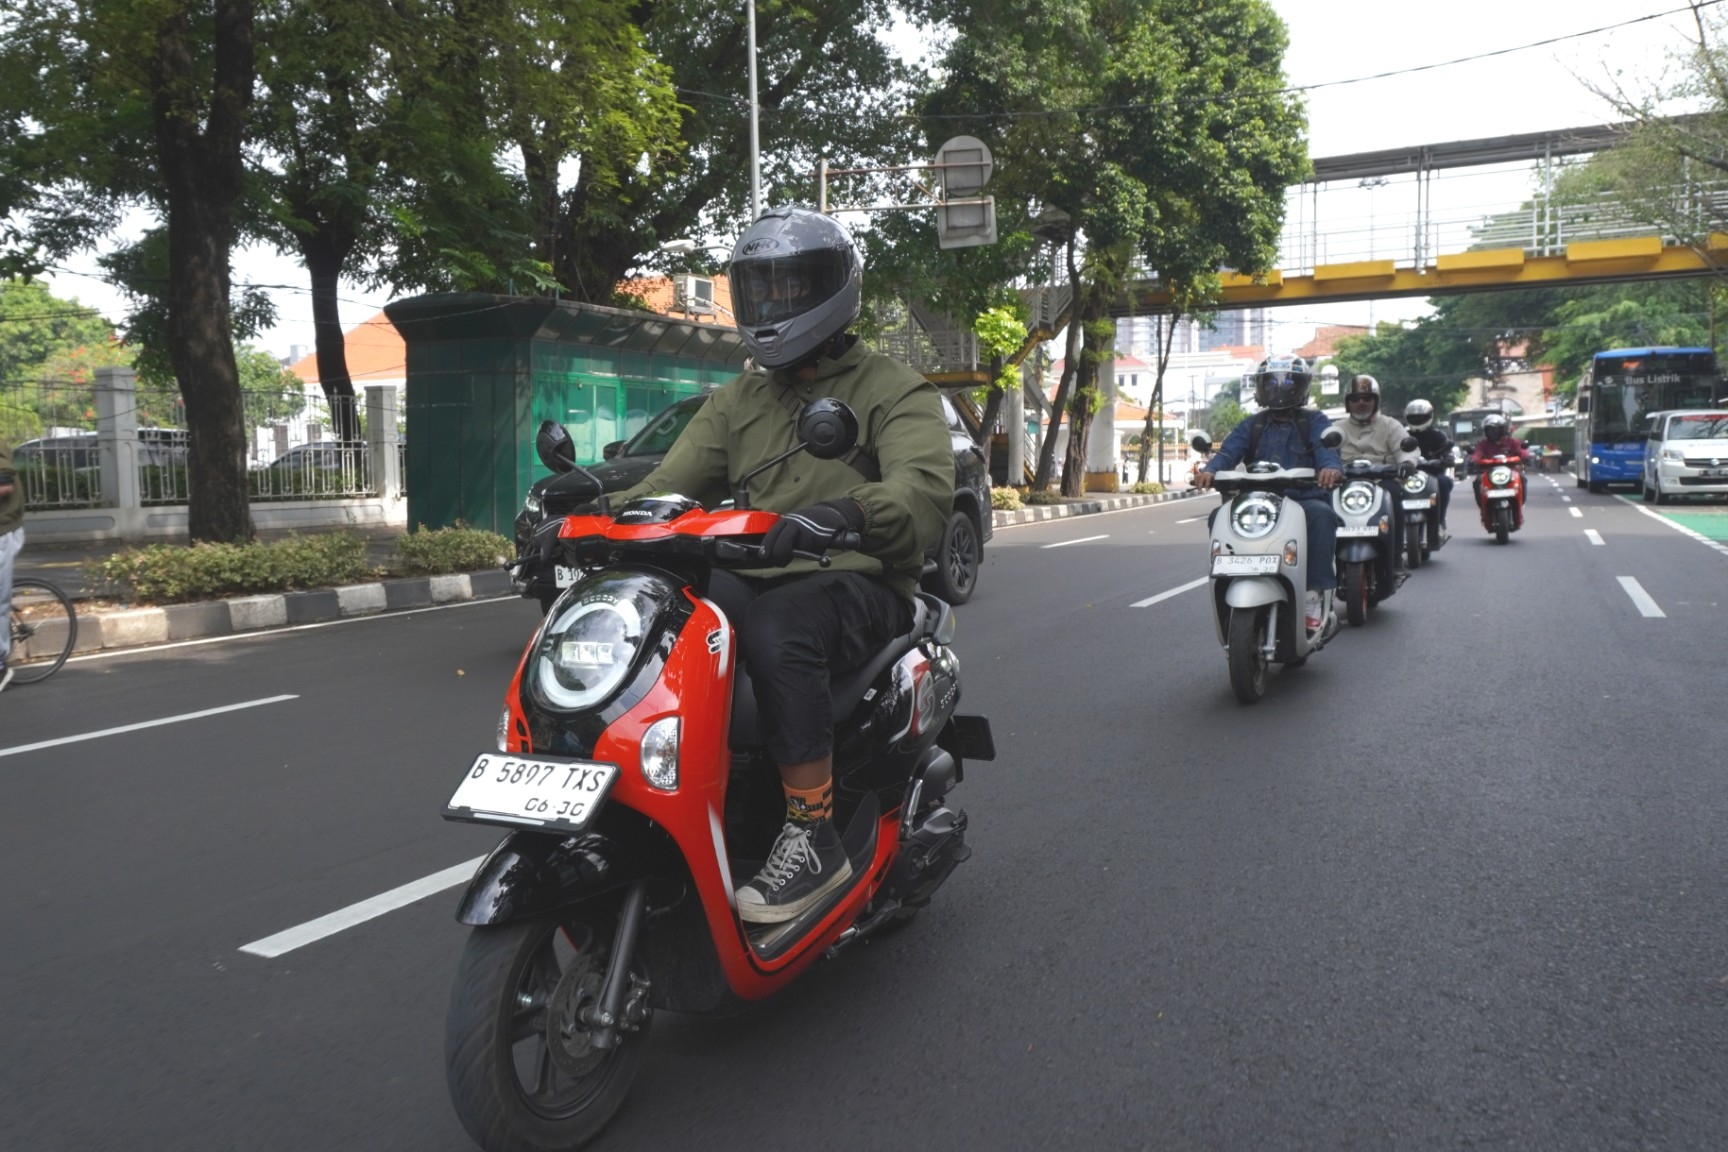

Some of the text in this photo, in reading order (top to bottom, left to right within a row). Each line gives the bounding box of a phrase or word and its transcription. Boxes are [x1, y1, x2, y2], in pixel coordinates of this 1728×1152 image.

[1625, 373, 1681, 385] Bus Listrik
[557, 569, 563, 580] B
[583, 594, 619, 605] SCOOPY
[471, 758, 606, 792] B 5897 TXS
